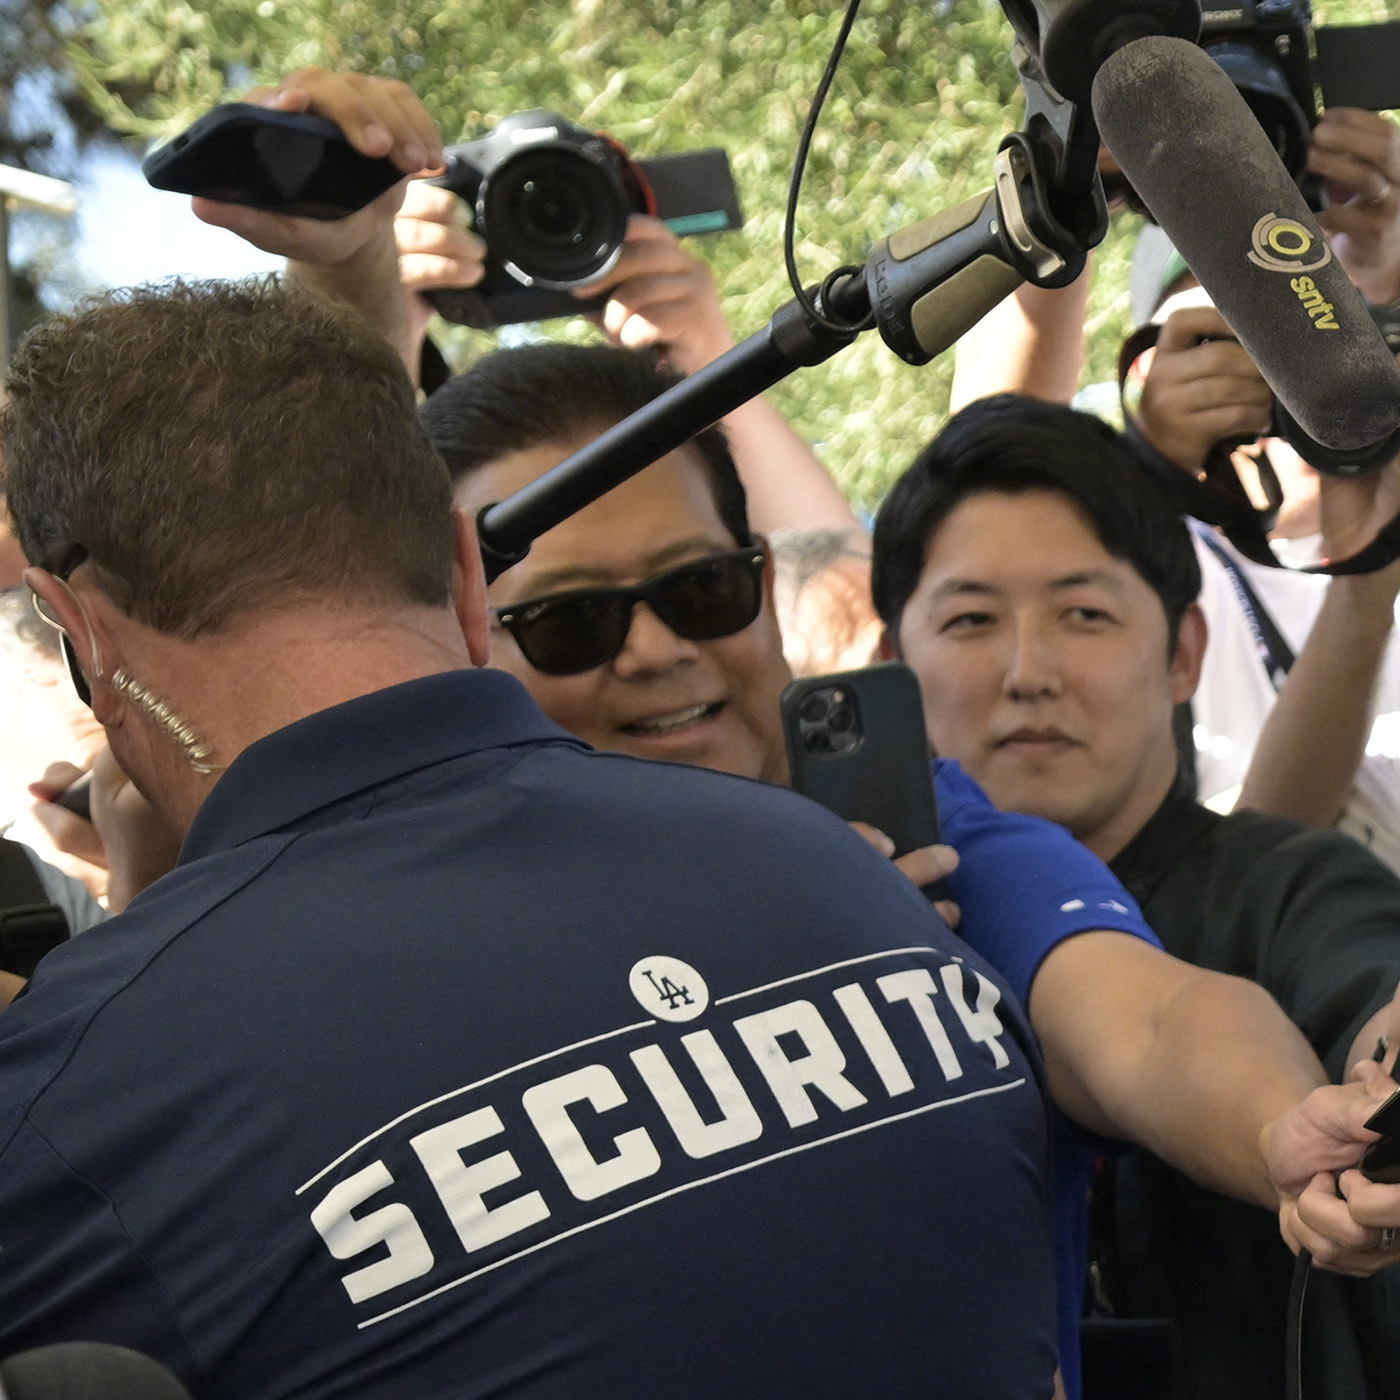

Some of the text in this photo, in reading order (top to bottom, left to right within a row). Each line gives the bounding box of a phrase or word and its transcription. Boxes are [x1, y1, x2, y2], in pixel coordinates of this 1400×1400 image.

[1290, 275, 1340, 330] sntv
[641, 969, 695, 1010] LA
[310, 964, 1010, 1304] SECURITY
